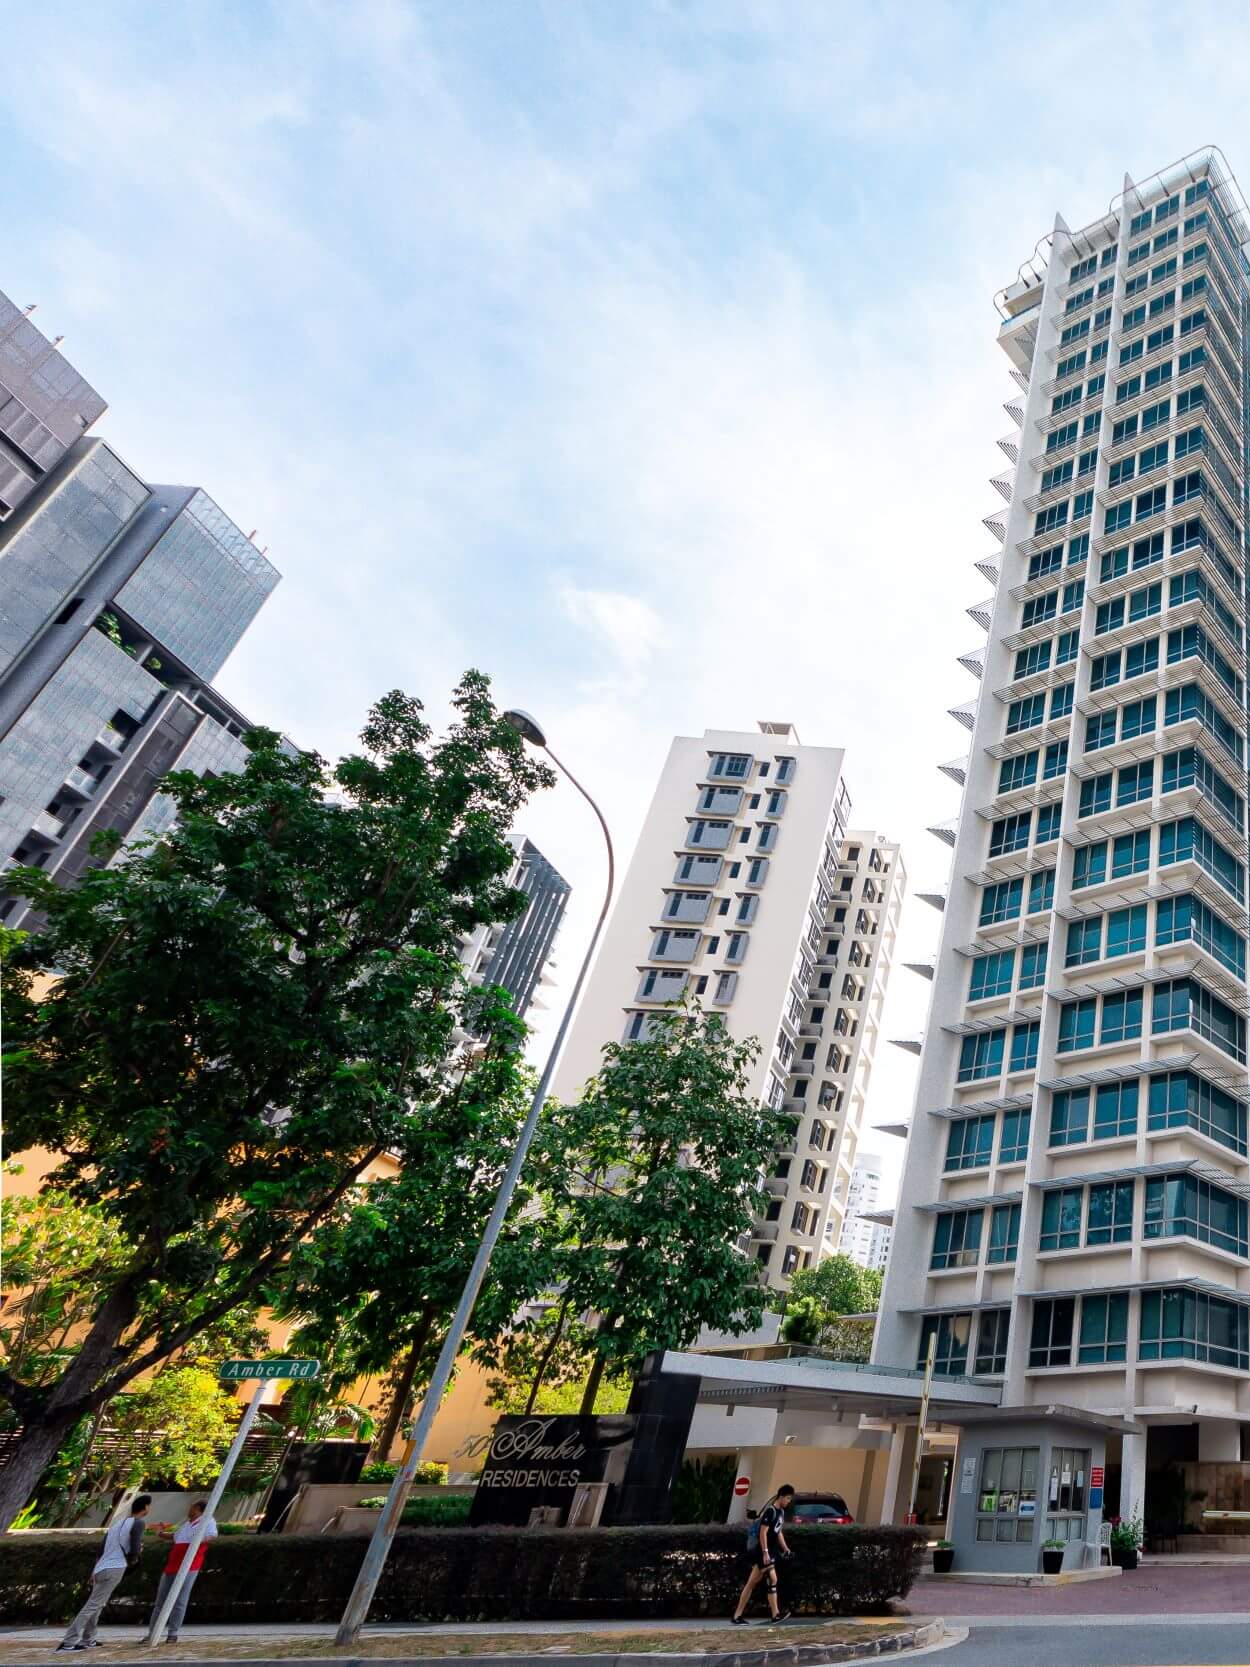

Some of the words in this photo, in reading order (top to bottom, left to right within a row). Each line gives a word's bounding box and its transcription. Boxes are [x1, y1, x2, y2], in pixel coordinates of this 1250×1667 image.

[227, 1362, 284, 1376] Amber
[288, 1362, 311, 1376] Rd
[491, 1417, 586, 1460] Amber
[480, 1470, 580, 1488] RESIDENCES
